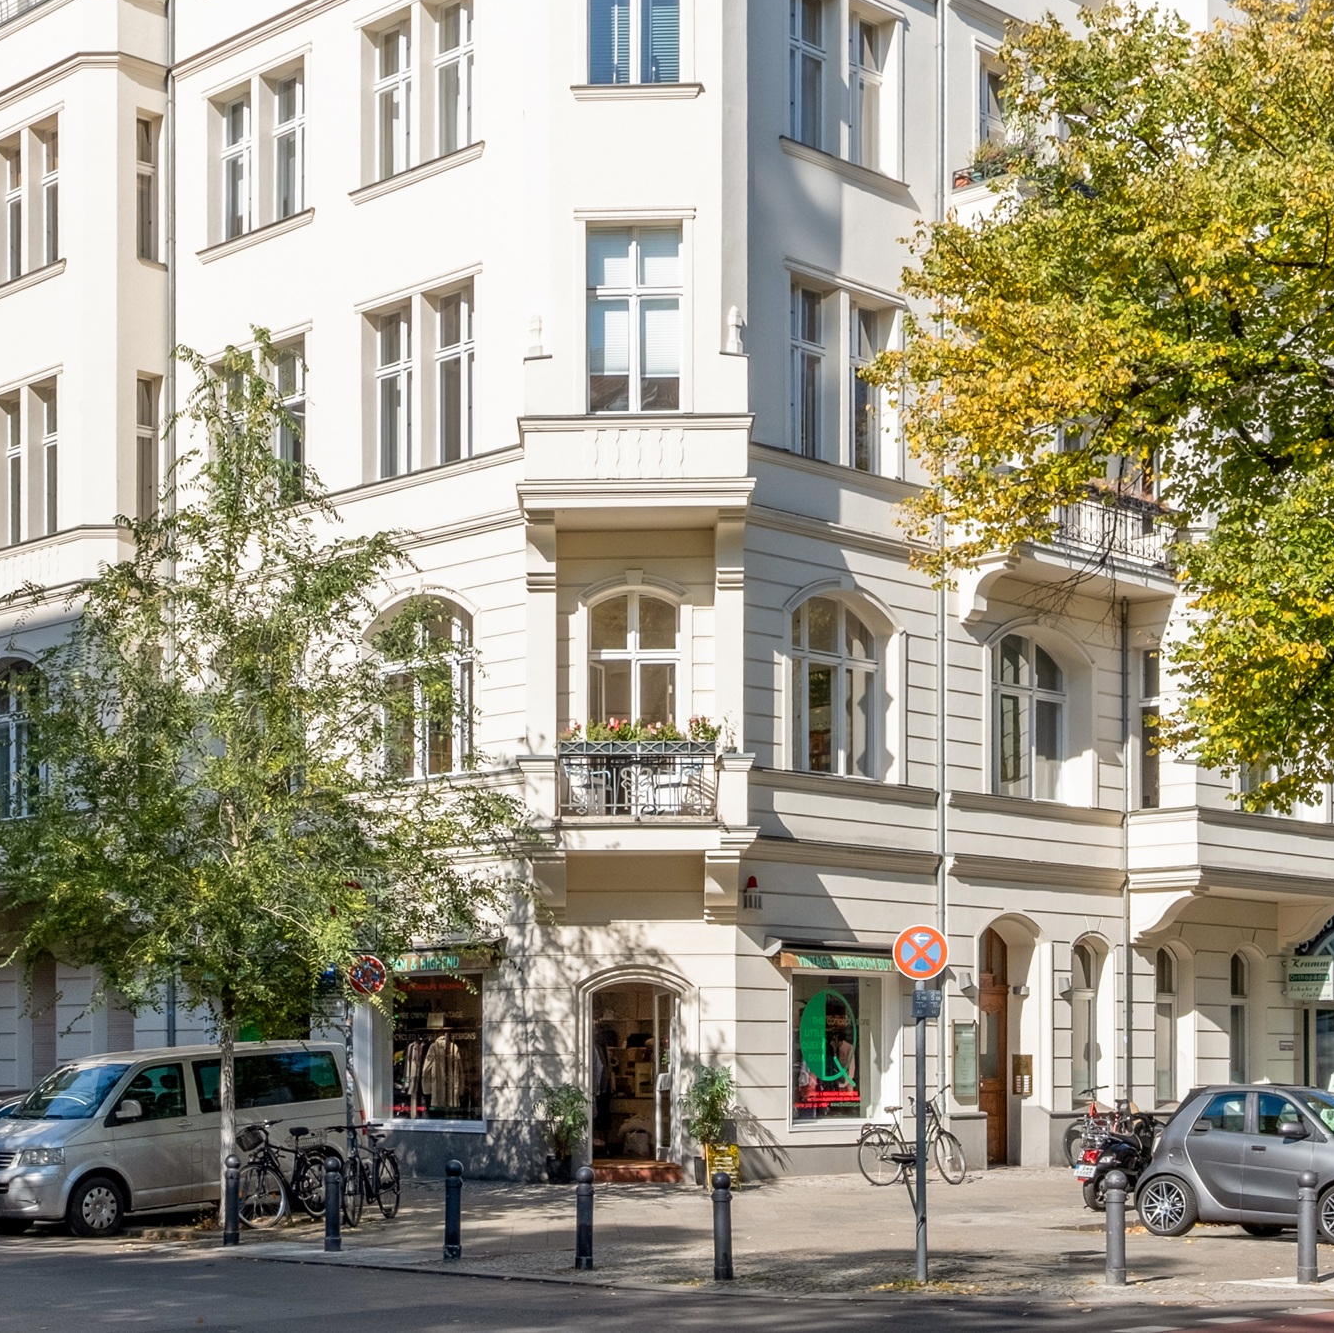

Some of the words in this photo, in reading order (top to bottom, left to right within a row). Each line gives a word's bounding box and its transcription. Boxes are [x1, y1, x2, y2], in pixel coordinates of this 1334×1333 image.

[797, 955, 832, 968] VINTAGE
[877, 958, 892, 971] BUY
[1291, 958, 1330, 968] Kramm
